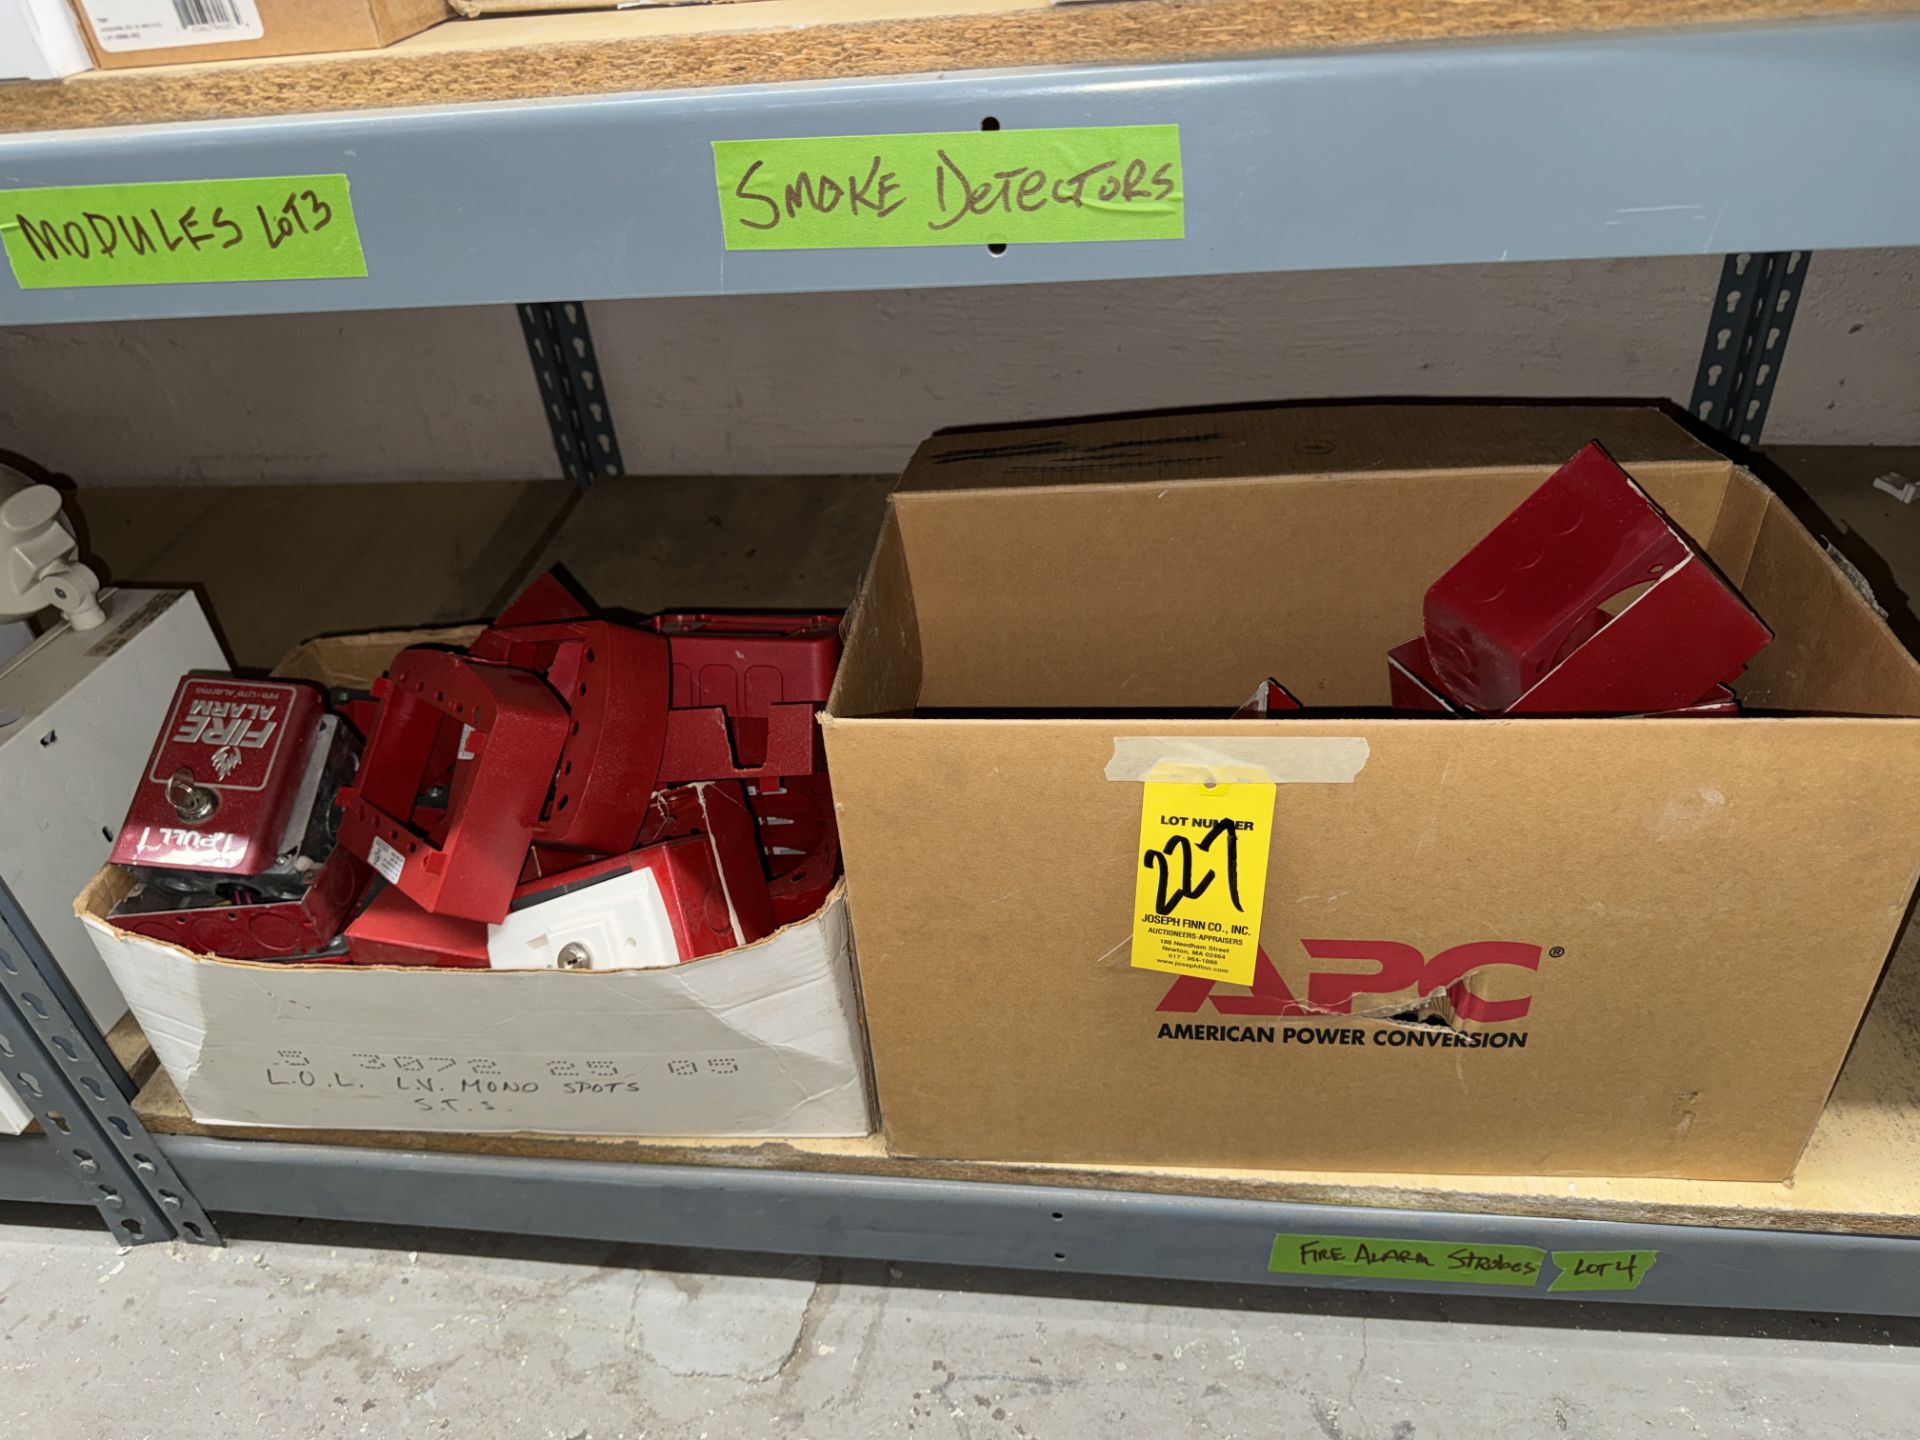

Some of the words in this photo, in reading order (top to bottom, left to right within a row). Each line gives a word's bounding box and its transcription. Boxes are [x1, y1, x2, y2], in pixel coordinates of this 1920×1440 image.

[735, 155, 907, 231] SMOKE
[16, 206, 244, 262] MODULES
[189, 699, 277, 721] ALARM
[172, 715, 278, 749] FIRE
[1160, 815, 1189, 827] LOT
[159, 827, 217, 851] PULL
[1143, 818, 1245, 916] 227
[1141, 914, 1181, 928] JOSEPH
[1182, 919, 1206, 930] FINN
[1231, 925, 1251, 936] INC.
[1162, 945, 1190, 955] Newton,
[1173, 940, 1207, 951] Needham
[1208, 945, 1230, 954] Street
[1156, 958, 1230, 974] www.josephfinn.com
[1157, 1023, 1275, 1044] AMERICAN
[1282, 1027, 1366, 1046] POWER
[1373, 1029, 1529, 1049] CONVERSION
[460, 1078, 539, 1094] MONO
[563, 1080, 641, 1095] SPOTS
[1300, 1240, 1346, 1265] FIRE
